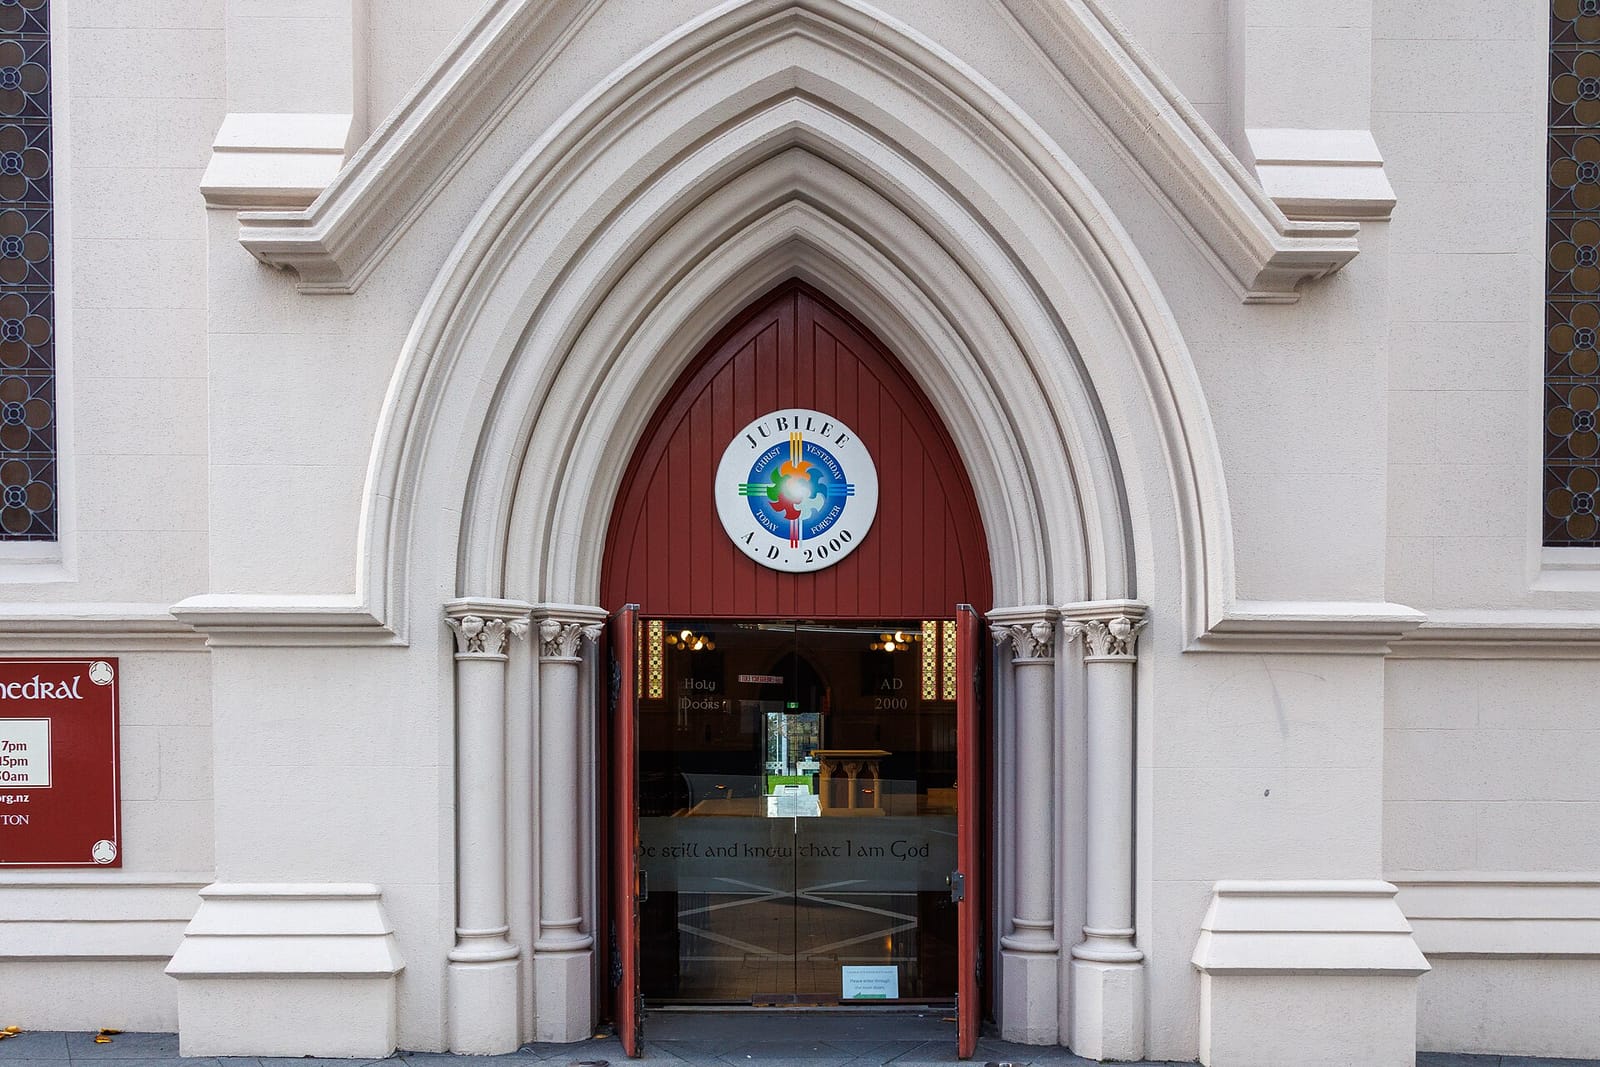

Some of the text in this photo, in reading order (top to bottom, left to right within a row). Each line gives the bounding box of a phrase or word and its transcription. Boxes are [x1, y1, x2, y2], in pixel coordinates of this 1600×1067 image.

[745, 415, 850, 449] JUBILEE
[755, 447, 781, 473] CHRIST
[805, 444, 842, 480] YESTERDAY
[756, 510, 779, 532] TODAY
[811, 505, 841, 535] FOREVER
[803, 529, 852, 564] 2000
[685, 678, 716, 692] Holy
[880, 678, 903, 690] AD
[875, 697, 908, 710] 2000
[1, 741, 27, 753] 7pm
[0, 794, 30, 805] rg.nz
[662, 842, 700, 858] still
[704, 843, 737, 858] and
[744, 843, 792, 858] know
[799, 842, 842, 857] that
[857, 846, 885, 857] am
[890, 840, 929, 861] God
